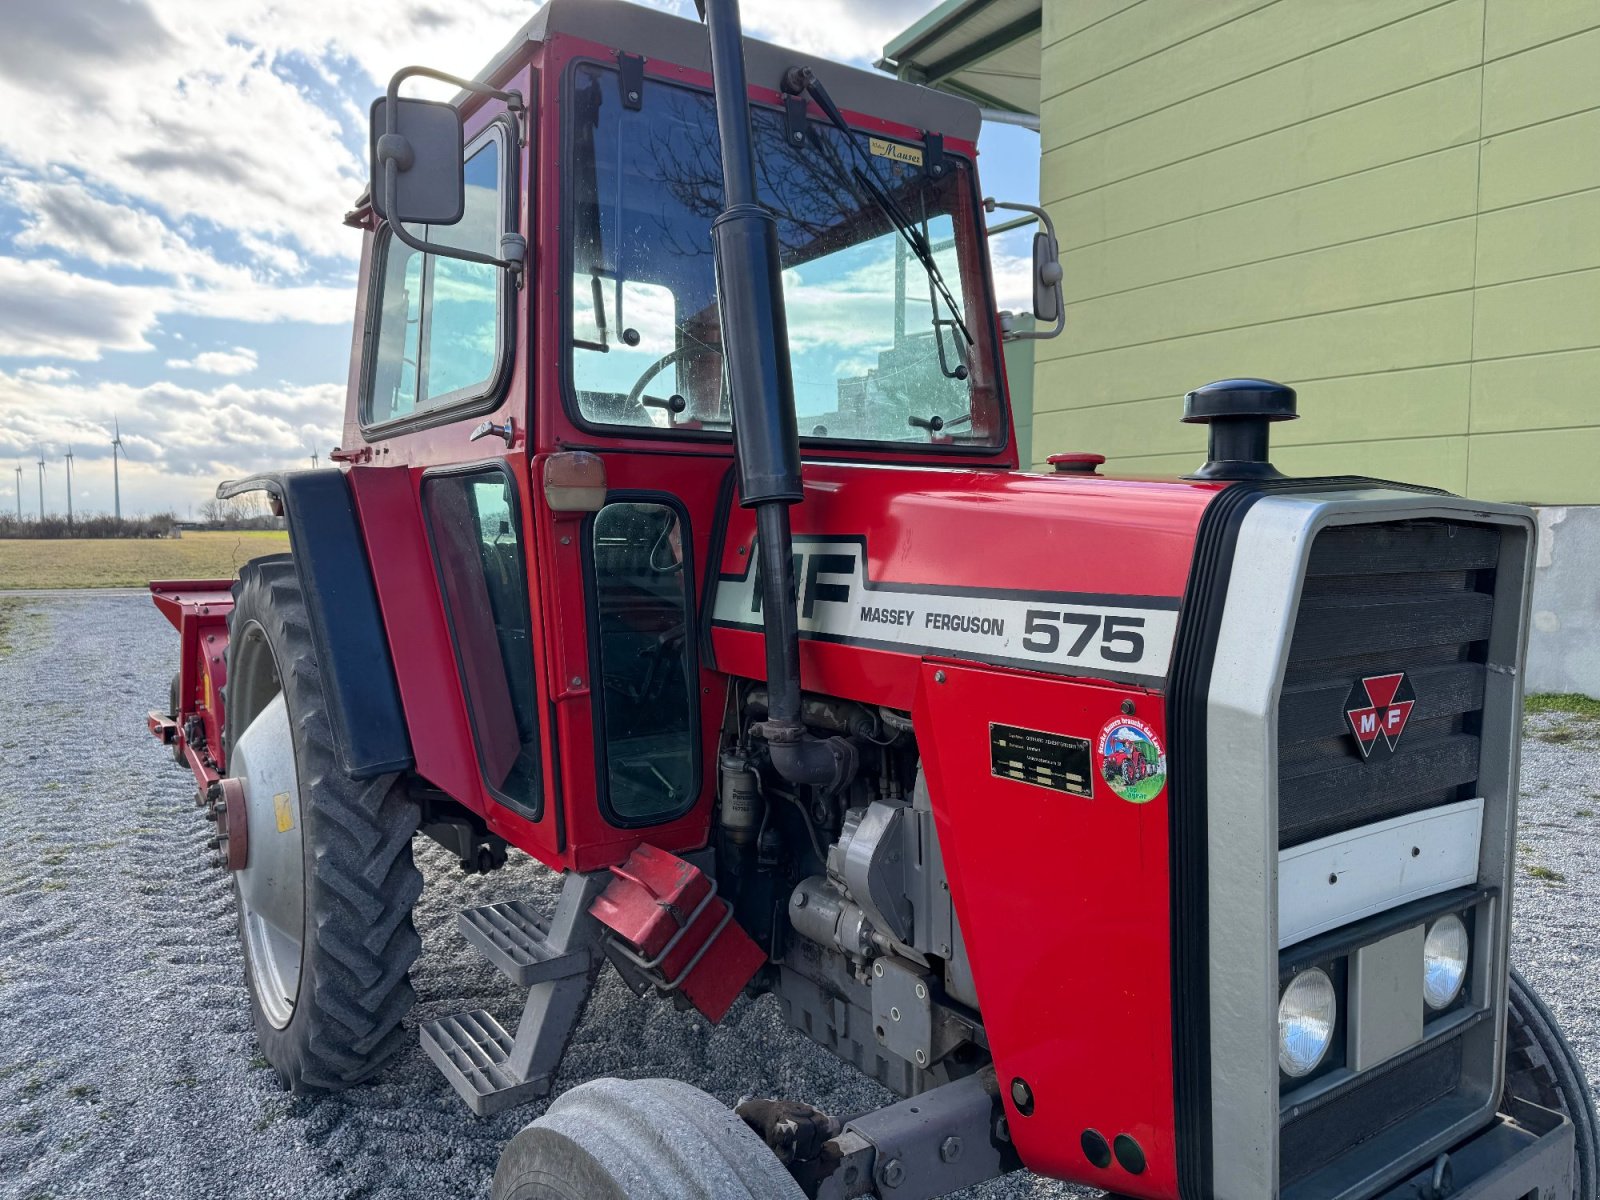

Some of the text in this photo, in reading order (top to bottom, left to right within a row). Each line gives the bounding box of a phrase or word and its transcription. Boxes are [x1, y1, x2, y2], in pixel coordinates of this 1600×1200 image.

[860, 606, 1146, 663] MASSEY FERGUSON 575
